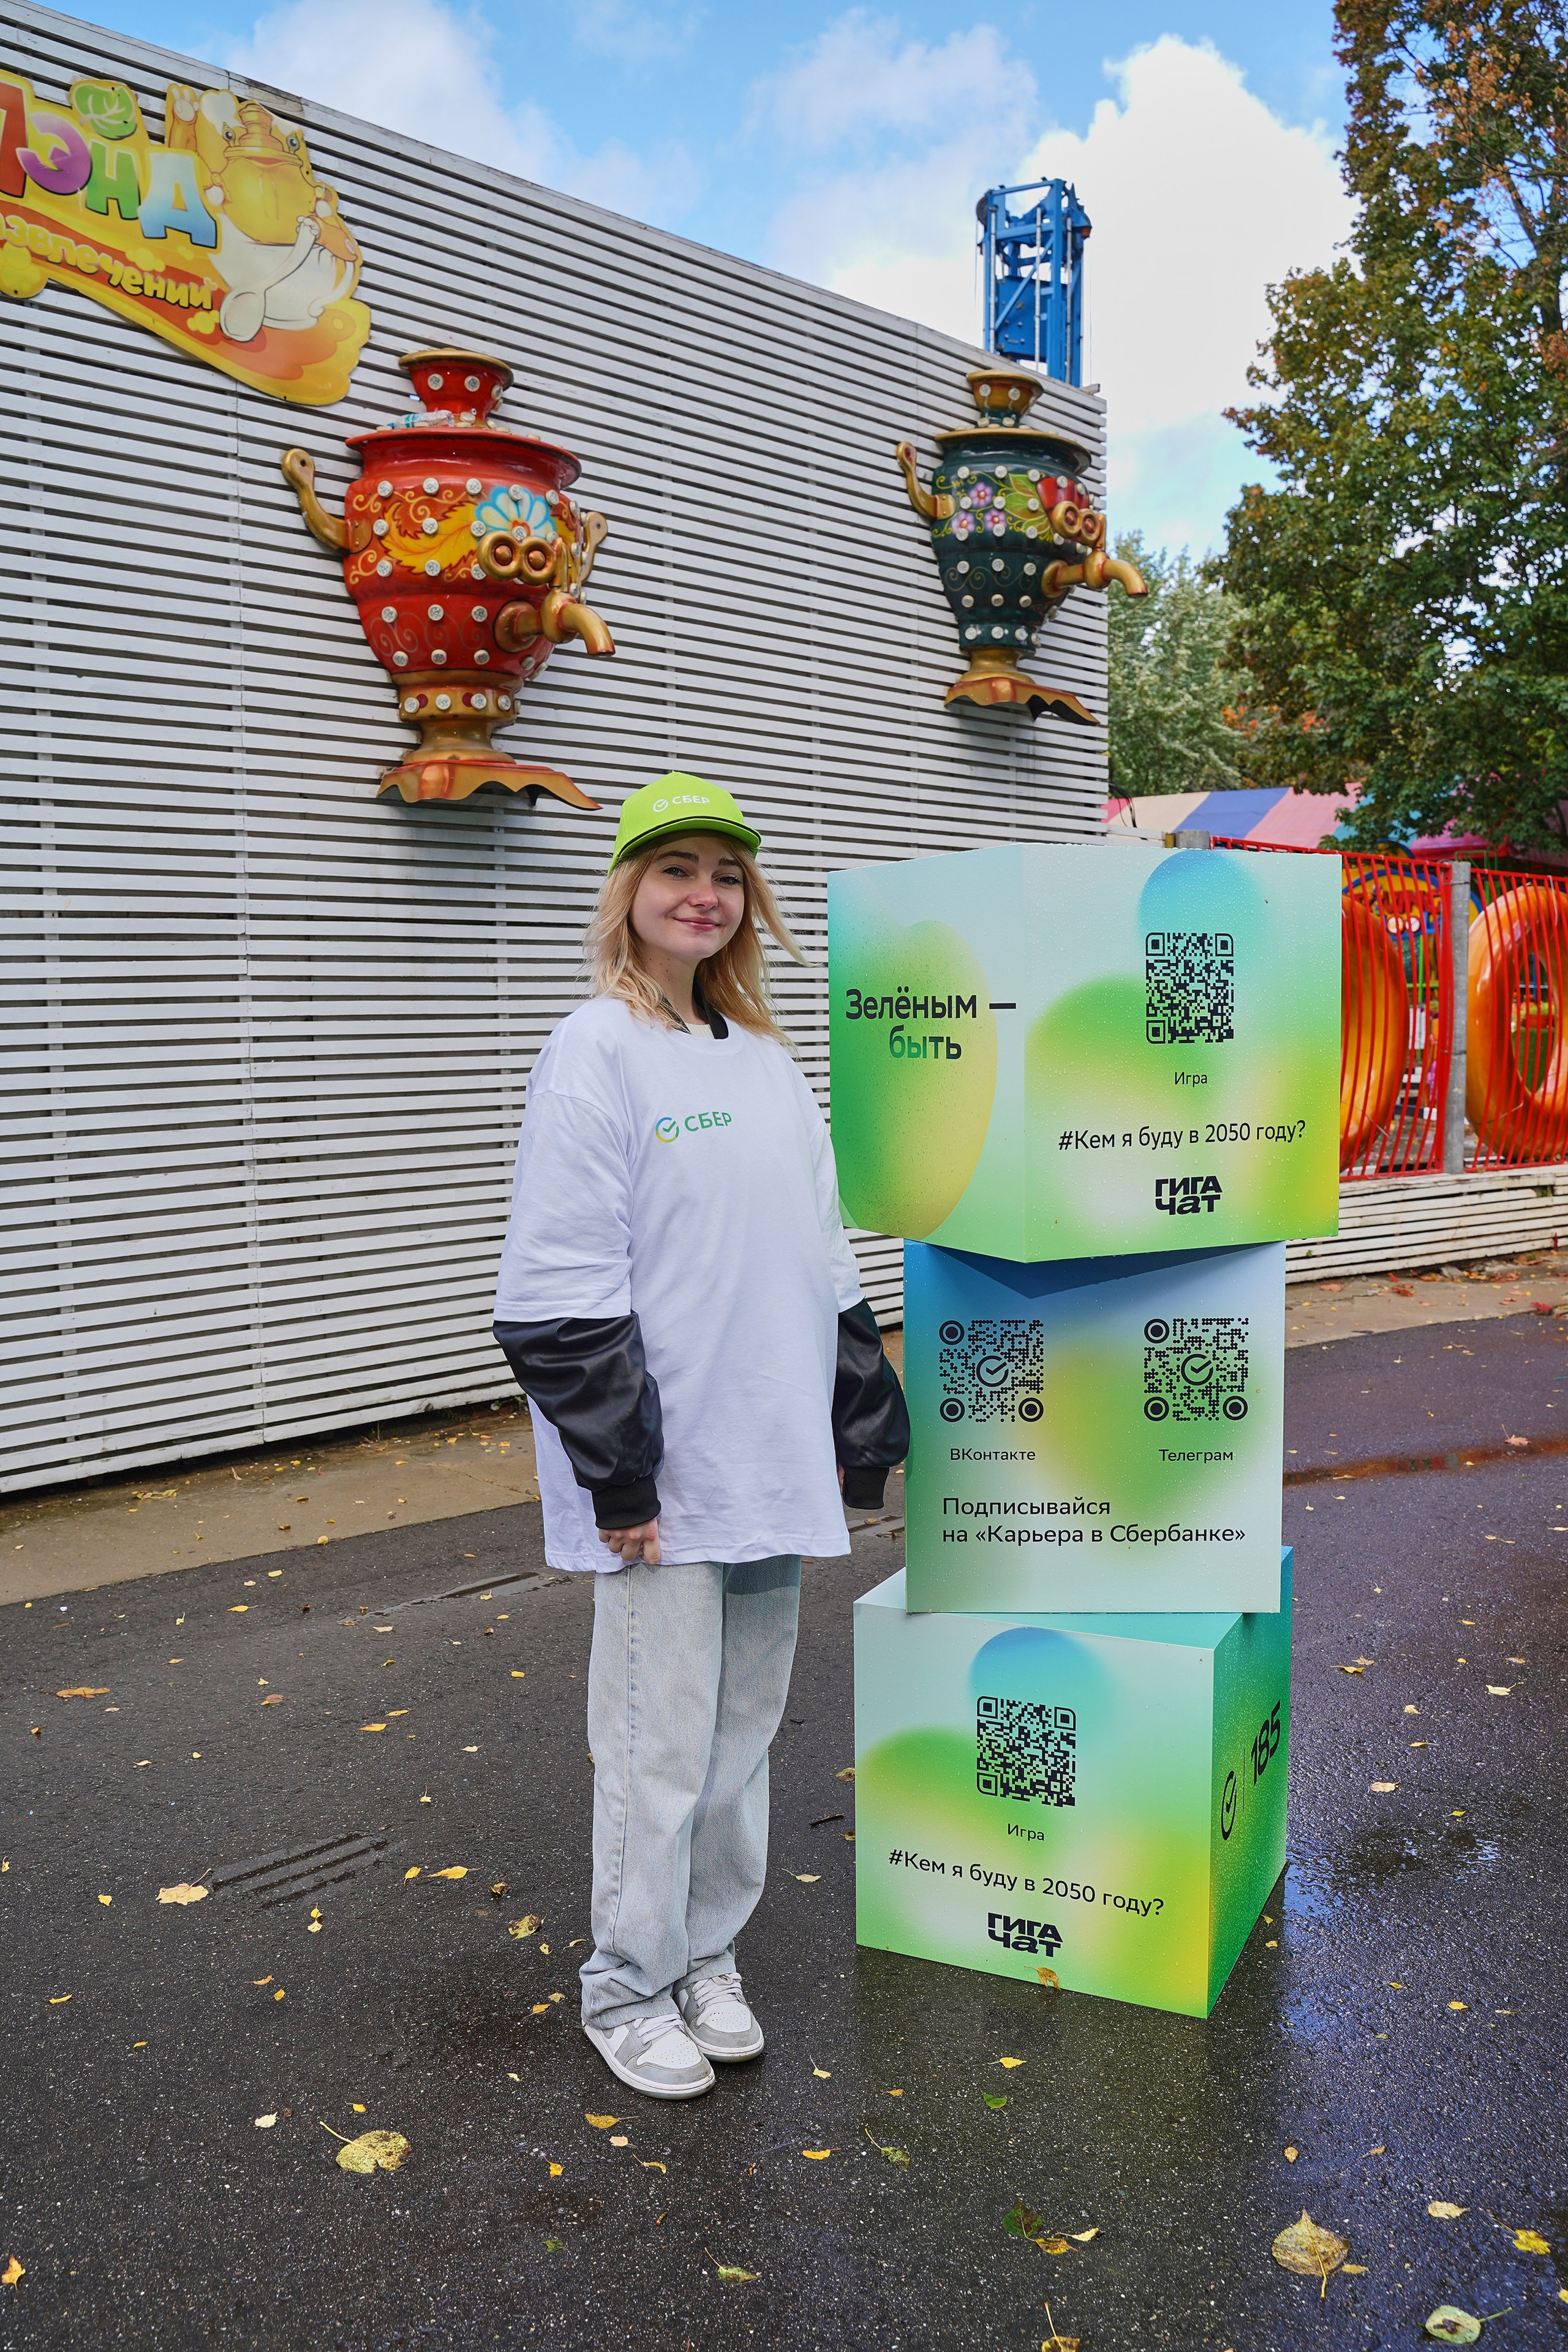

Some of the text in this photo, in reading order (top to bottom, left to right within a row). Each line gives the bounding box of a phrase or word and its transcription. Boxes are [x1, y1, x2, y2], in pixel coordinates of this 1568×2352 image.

[0, 212, 218, 311] звлечений
[672, 795, 710, 804] СБЕР
[846, 986, 977, 1020] Зелёным
[889, 1024, 962, 1060] быть
[1175, 1071, 1207, 1088] Игра
[684, 1111, 732, 1132] СБЕР
[1058, 1120, 1306, 1150] #Кем я буду в 2050 году?
[1155, 1175, 1223, 1197] ГИГА
[950, 1448, 1036, 1461] ВКонтакте
[1158, 1449, 1233, 1464] Телеграм
[943, 1496, 1110, 1518] Подписывайся
[943, 1523, 1246, 1547] на «Карьера в Сбербанке»
[1251, 1699, 1281, 1787] 185
[1008, 1823, 1044, 1842] Игра
[888, 1849, 1164, 1917] #Кем я буду в 2050 году?
[987, 1912, 1063, 1943] ГИГА
